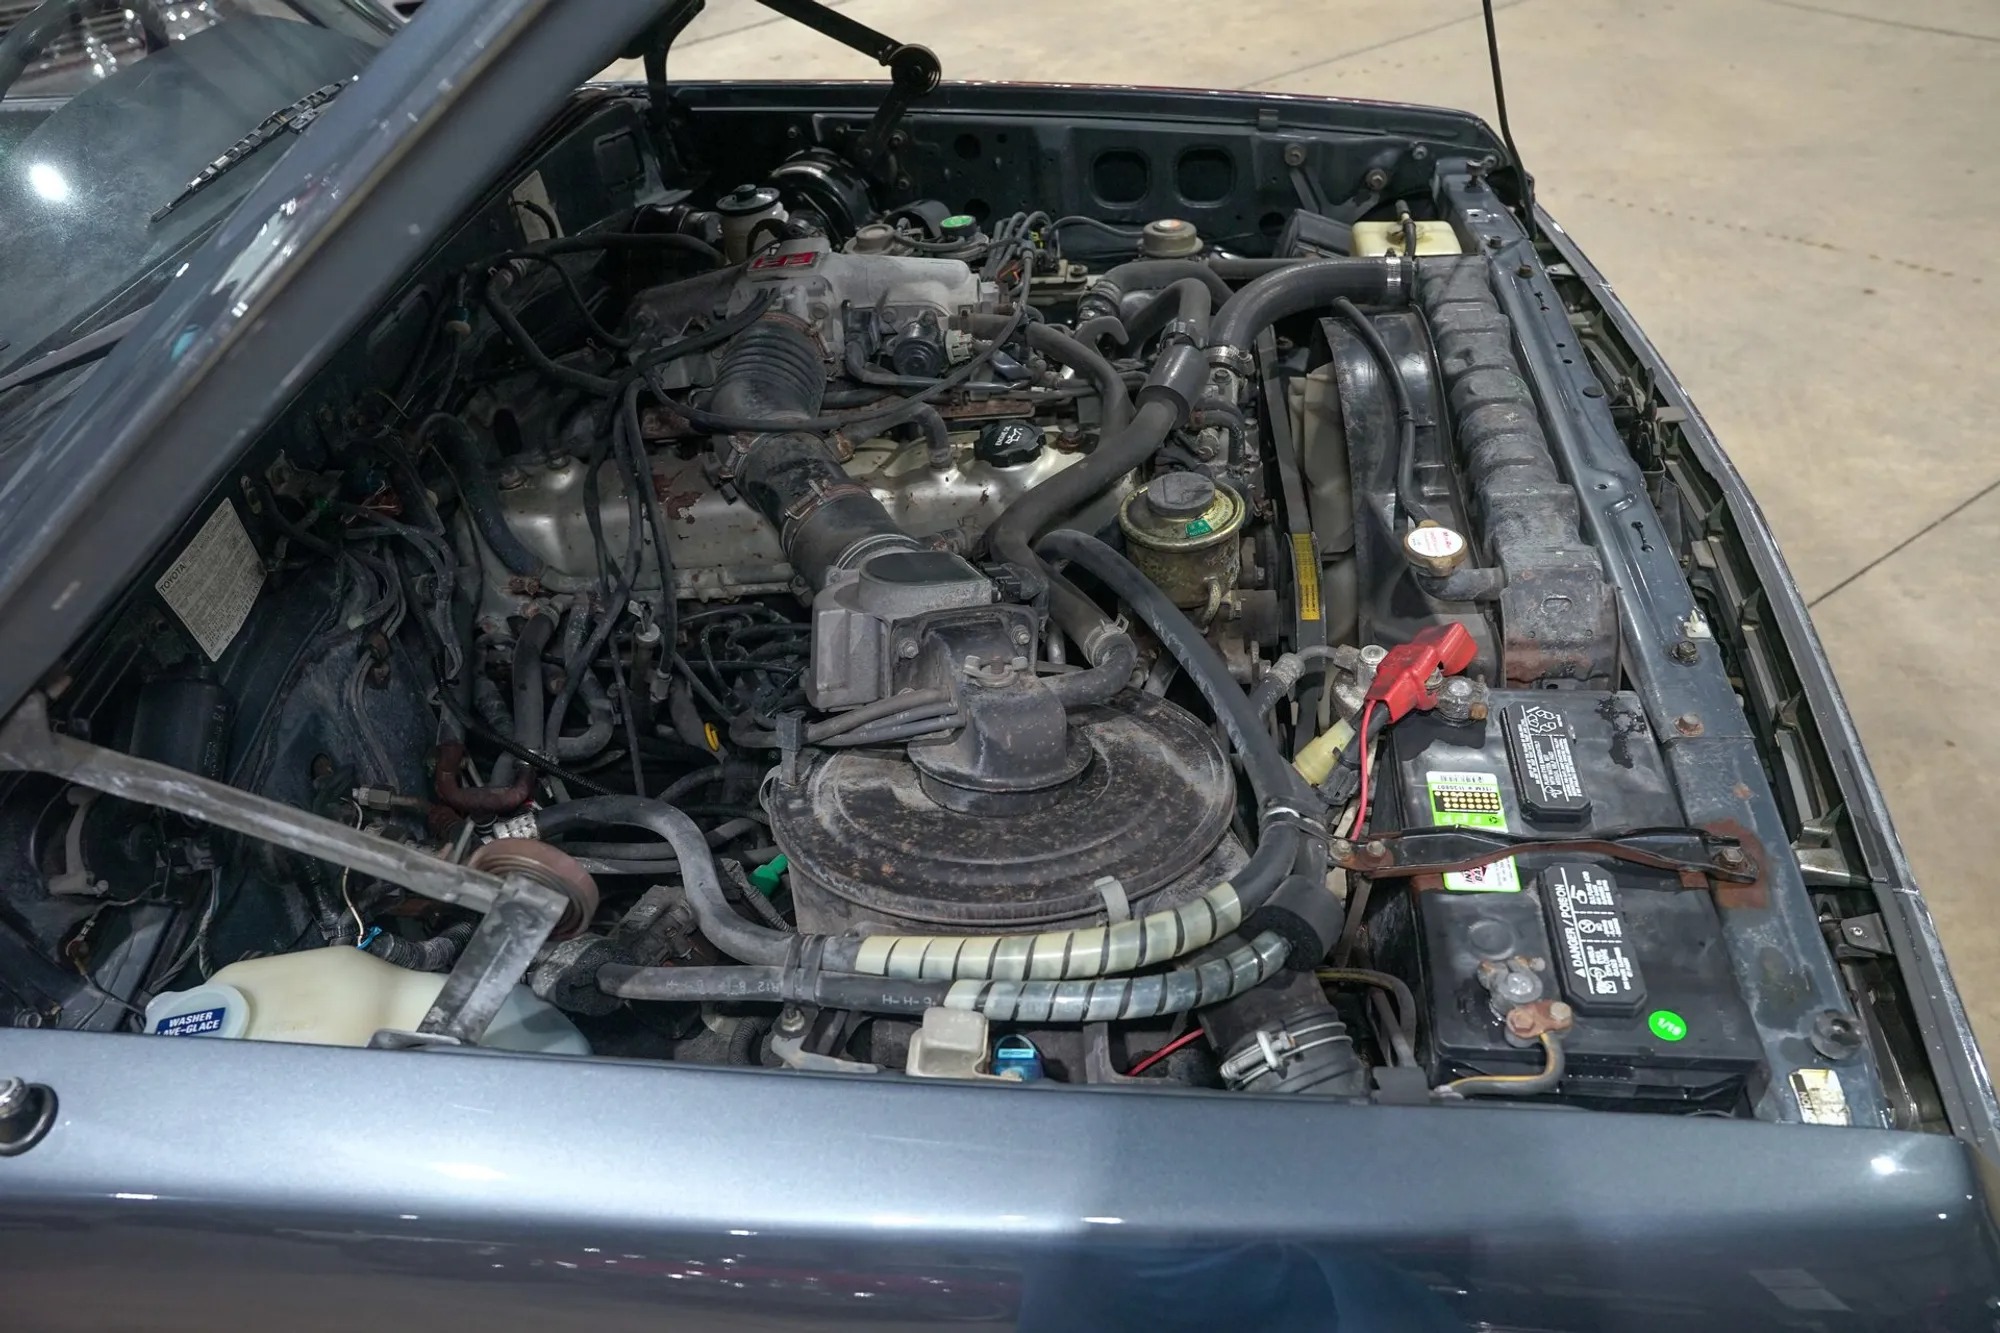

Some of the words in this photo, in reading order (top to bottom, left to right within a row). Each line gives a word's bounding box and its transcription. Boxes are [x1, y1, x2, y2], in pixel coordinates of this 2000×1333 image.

[159, 563, 186, 593] TOYOTA
[1554, 884, 1571, 917] POISON
[1564, 928, 1582, 966] DANGER
[156, 1019, 220, 1036] AVE-GLACE
[168, 1011, 213, 1027] WASHER
